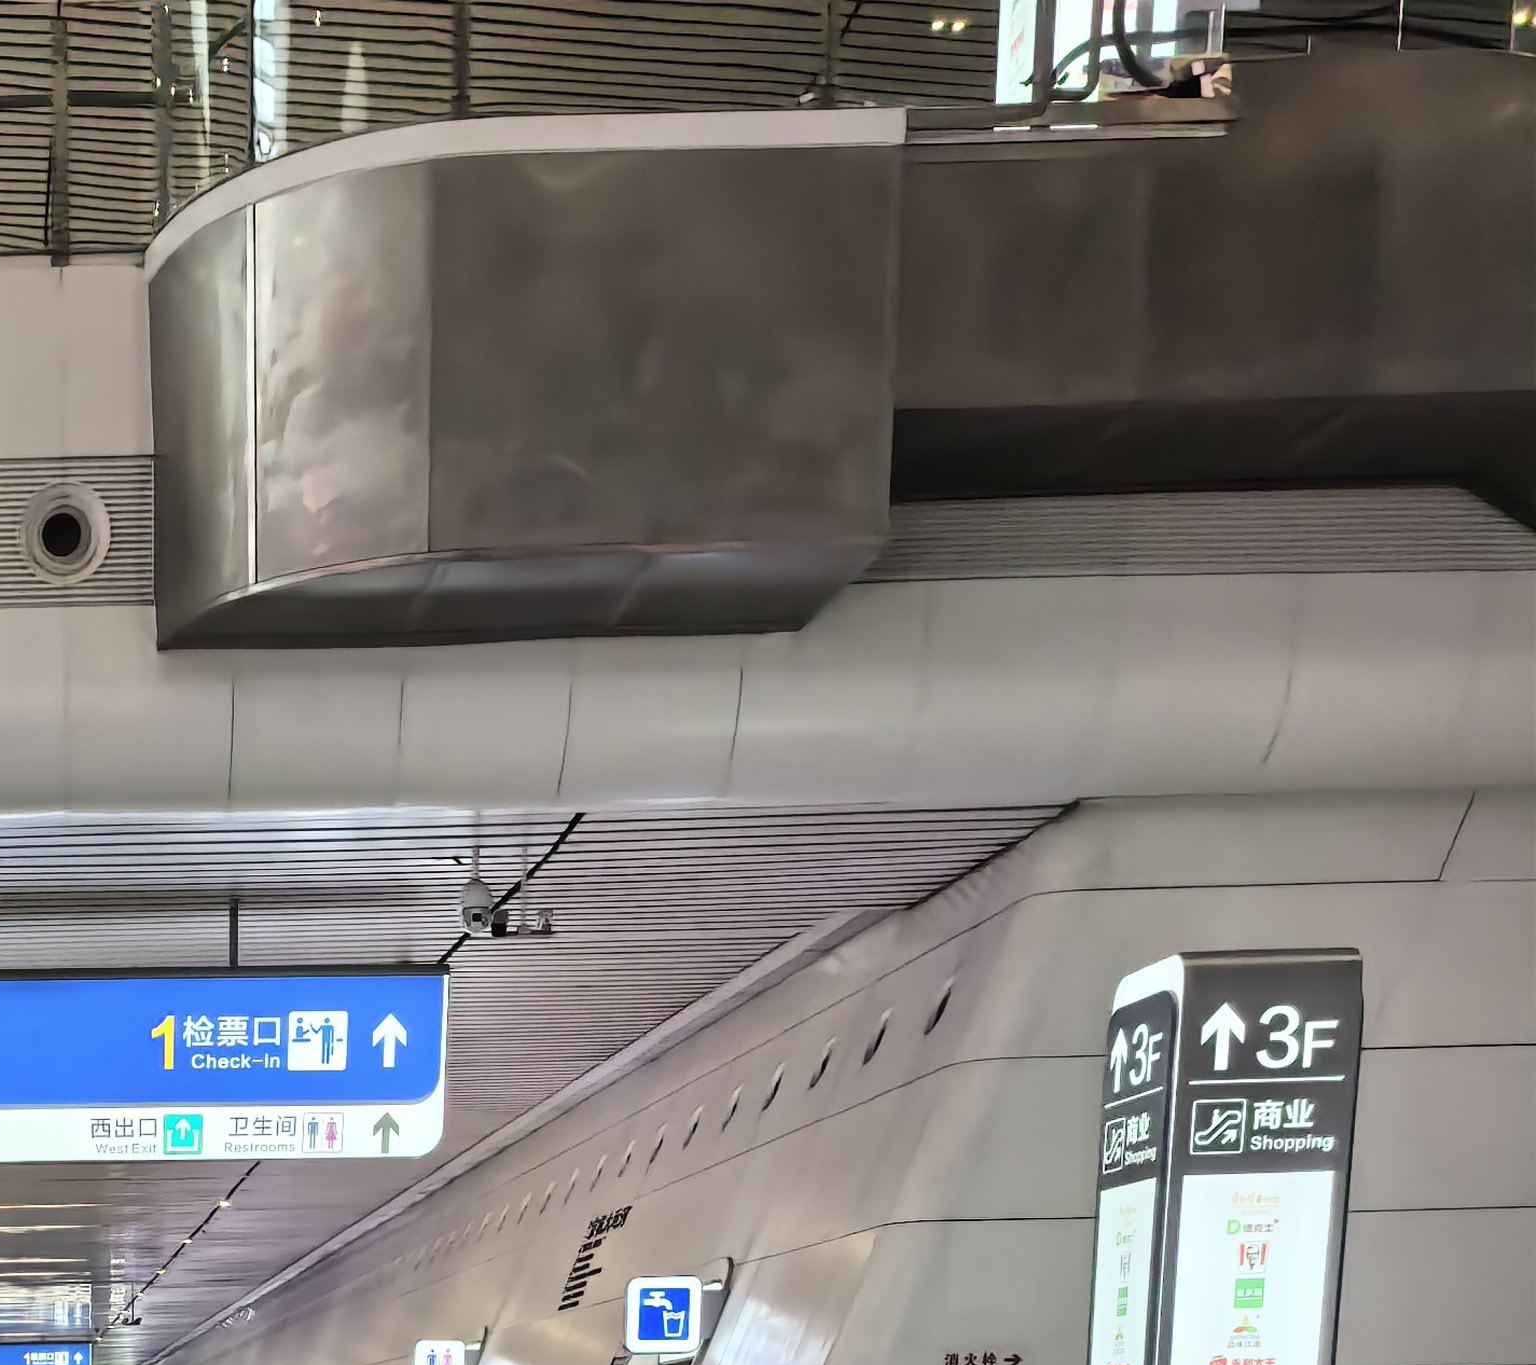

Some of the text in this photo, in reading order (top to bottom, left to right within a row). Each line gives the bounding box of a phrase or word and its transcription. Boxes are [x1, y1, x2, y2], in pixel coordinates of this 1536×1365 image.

[151, 1015, 281, 1070] 1 检票口
[1256, 1004, 1340, 1069] 3F
[1129, 1023, 1164, 1086] 3F
[90, 1117, 157, 1139] 西出口
[228, 1115, 297, 1137] 卫生间
[1252, 1099, 1315, 1131] 商业
[1126, 1111, 1151, 1147] 商业
[95, 1142, 156, 1155] West Exit
[224, 1142, 296, 1153] Restrooms
[1249, 1134, 1335, 1153] Shopping
